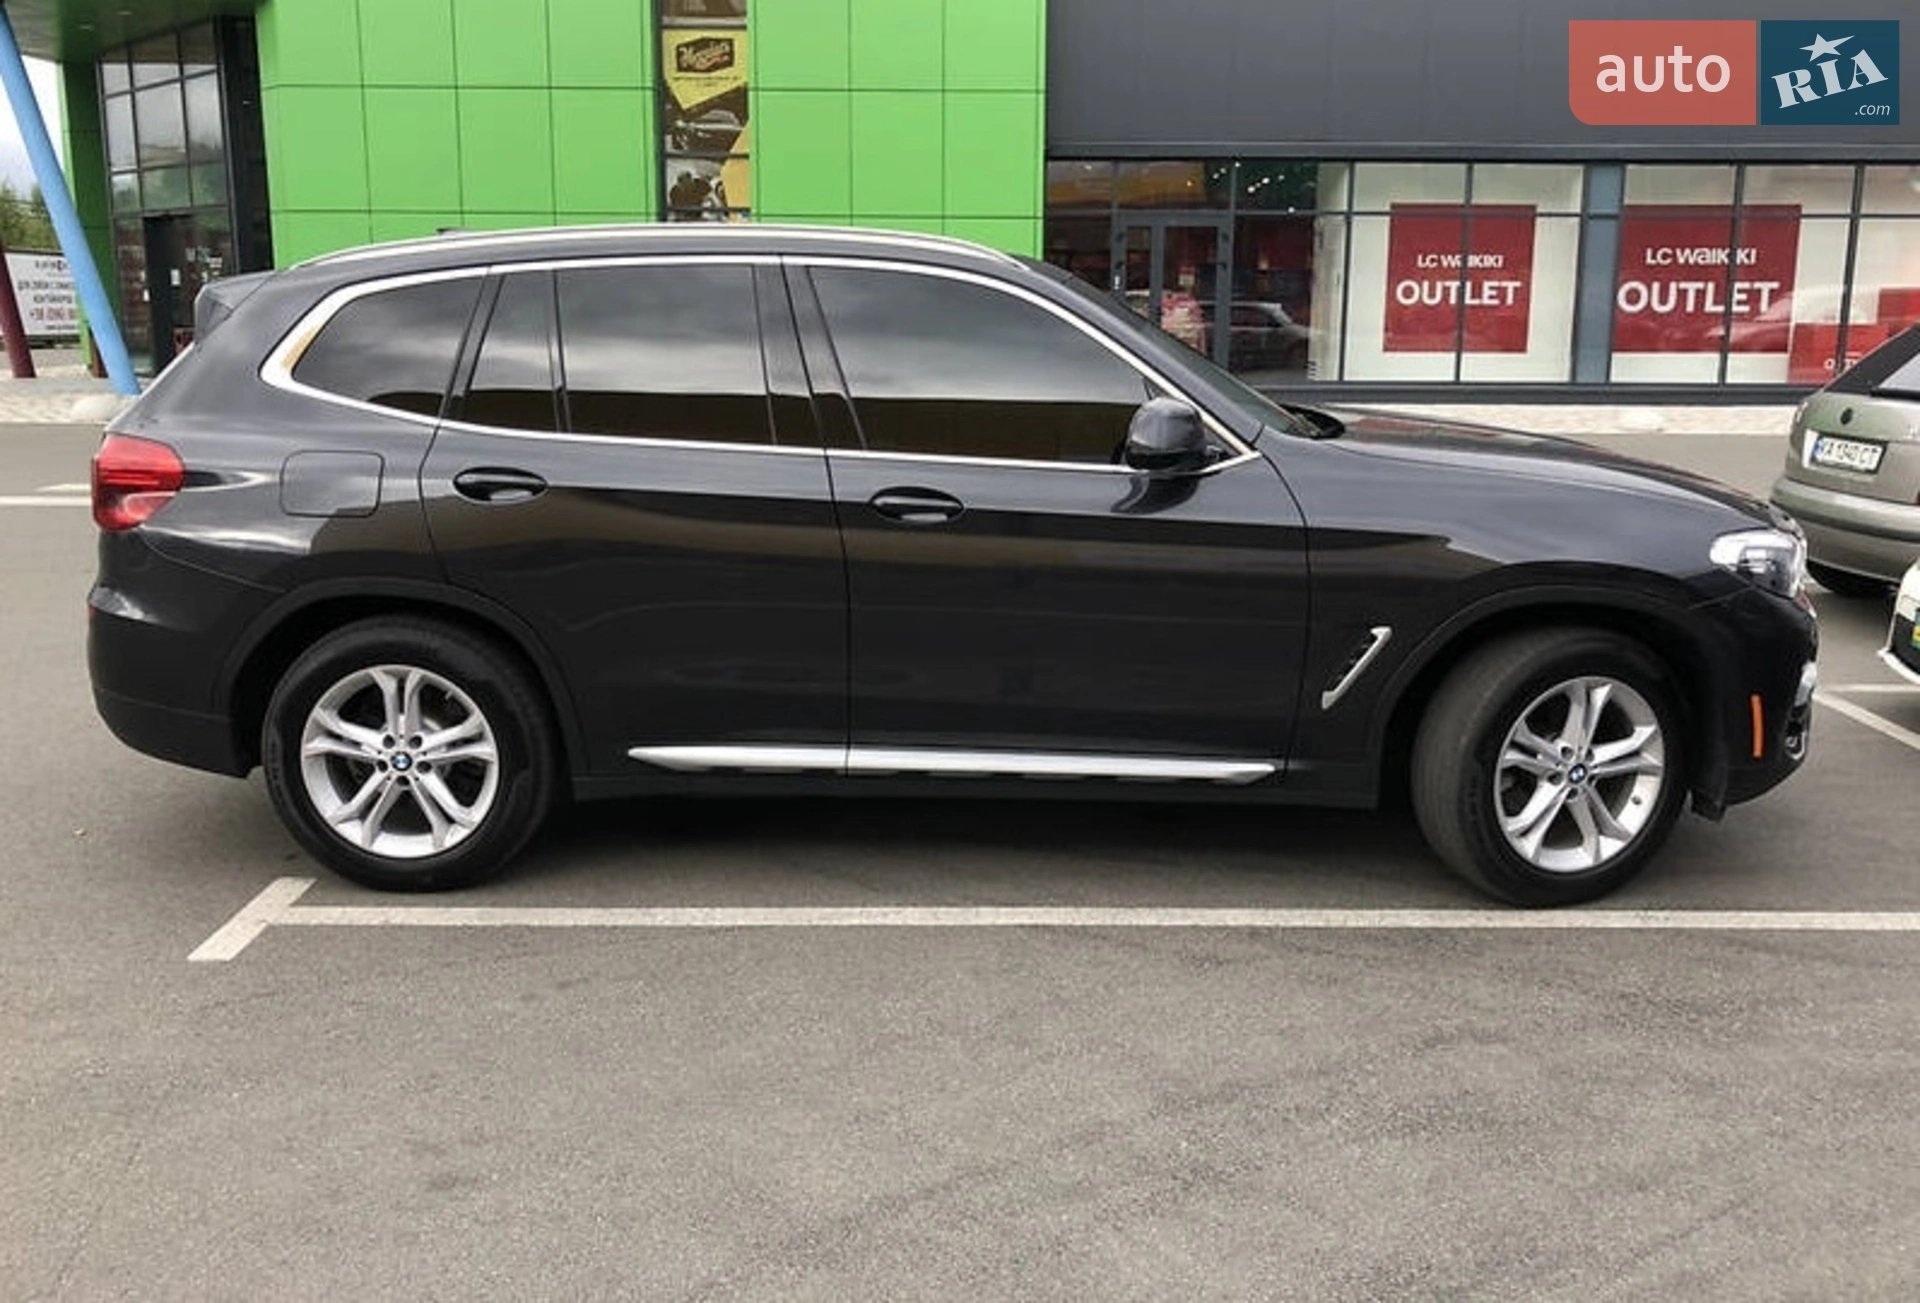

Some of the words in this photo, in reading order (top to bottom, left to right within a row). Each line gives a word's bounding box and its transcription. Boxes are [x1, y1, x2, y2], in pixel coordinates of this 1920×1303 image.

[1417, 254, 1438, 269] LC
[1645, 247, 1673, 266] LC
[1396, 279, 1522, 306] OUTLET
[1617, 281, 1780, 314] OUTLET
